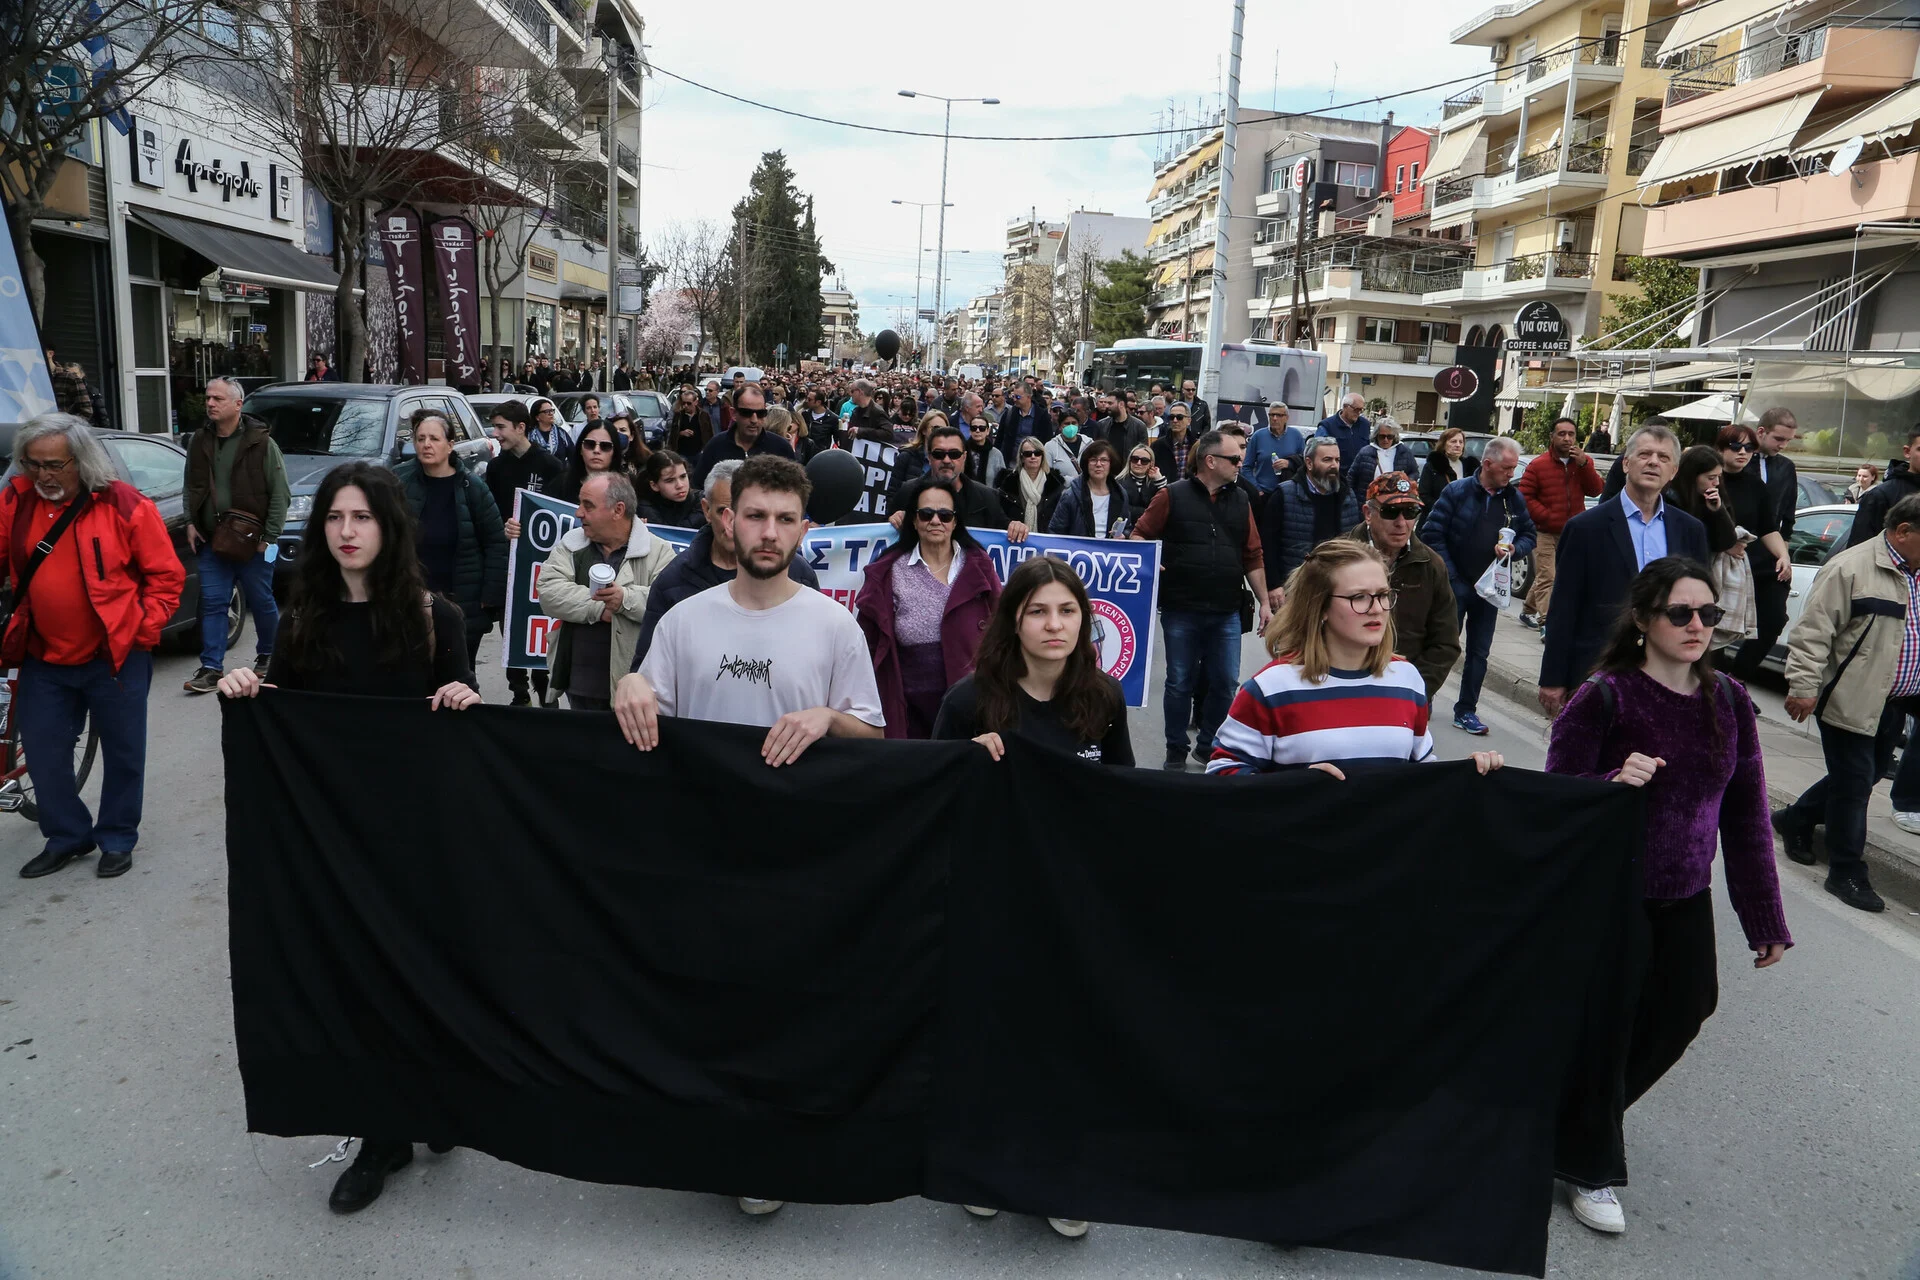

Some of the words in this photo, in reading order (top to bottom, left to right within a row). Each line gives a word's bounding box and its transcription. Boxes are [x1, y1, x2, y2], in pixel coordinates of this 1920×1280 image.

[1520, 320, 1535, 335] για
[1536, 320, 1559, 333] σενα
[1508, 341, 1537, 350] COFFEE
[1542, 341, 1568, 350] ΚΑΦΕΣ
[1098, 603, 1130, 634] ΚΕΝΤΡΟ
